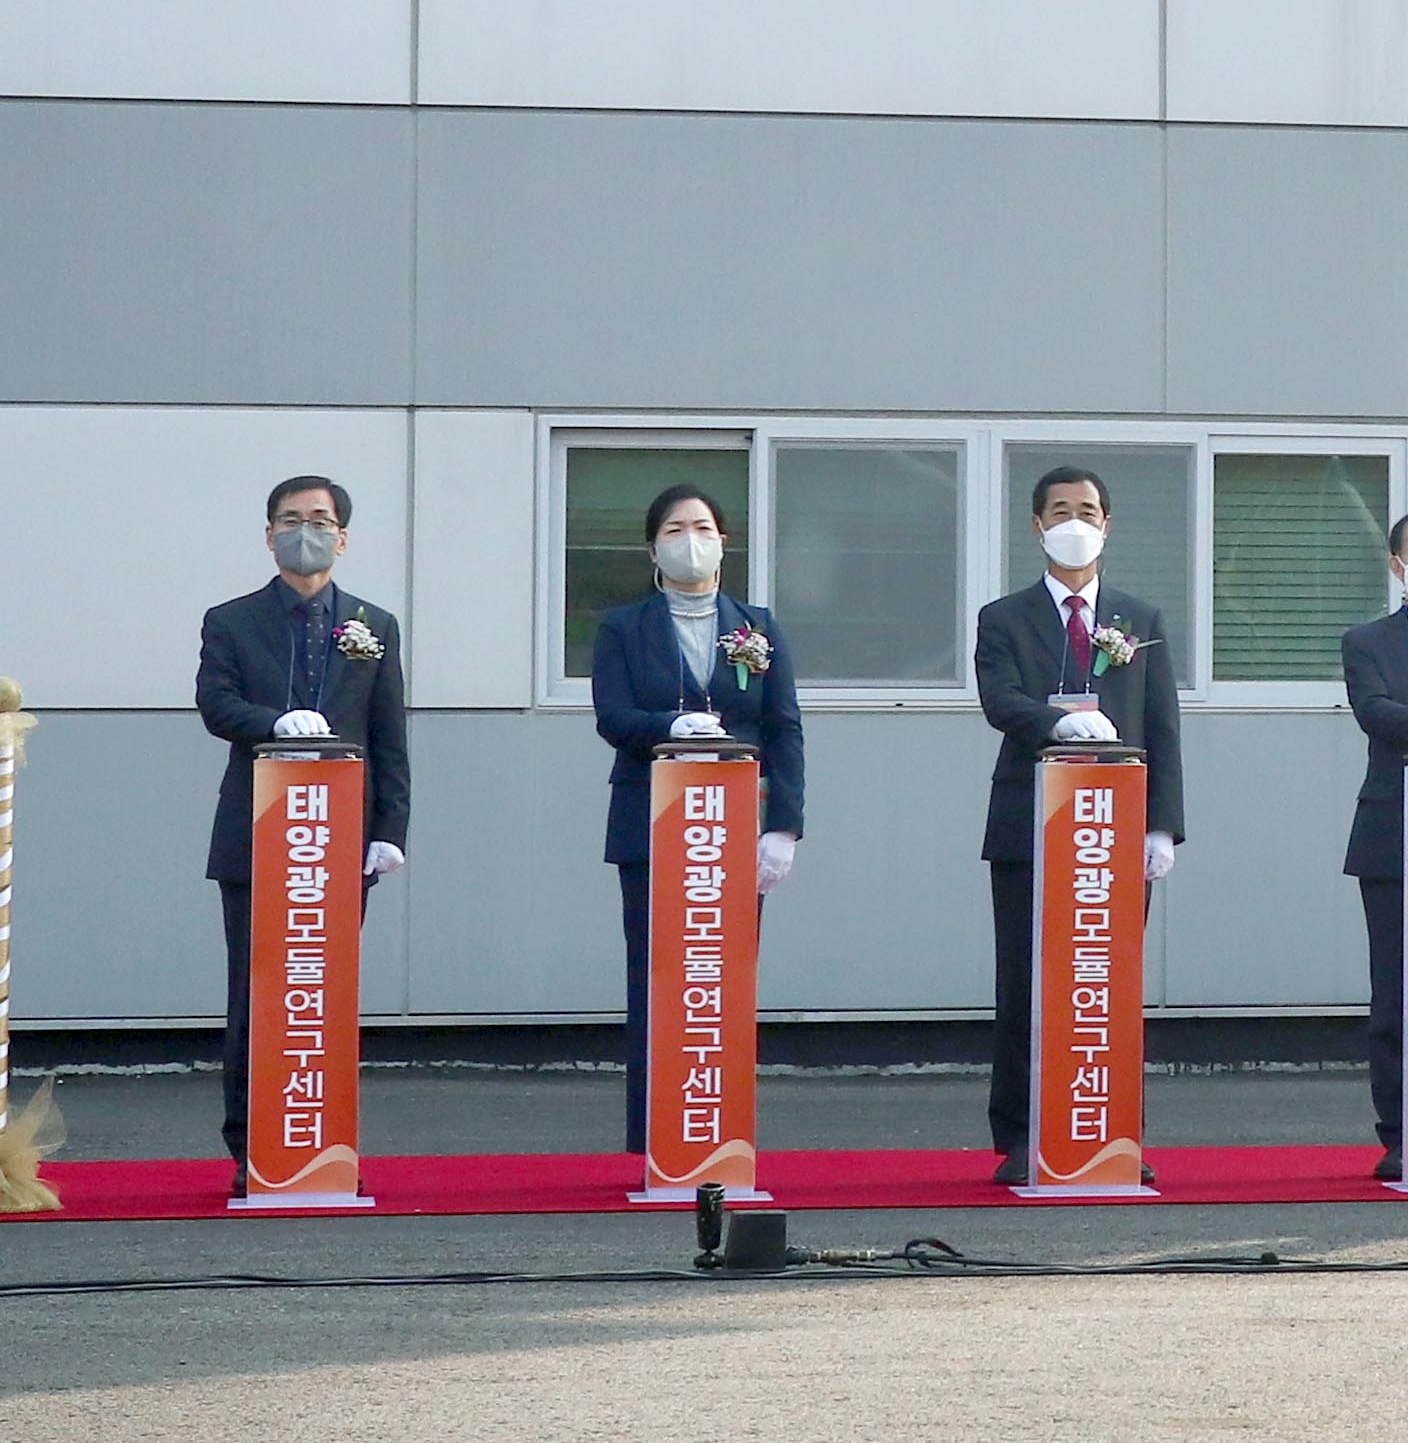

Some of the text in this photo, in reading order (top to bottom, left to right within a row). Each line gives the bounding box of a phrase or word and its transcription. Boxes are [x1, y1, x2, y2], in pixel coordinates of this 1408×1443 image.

[282, 784, 330, 1150] 태양광모듈연구센터
[681, 785, 727, 1145] 태양광모듈연구센터
[1070, 788, 1115, 1143] 태양광모듈연구센터
